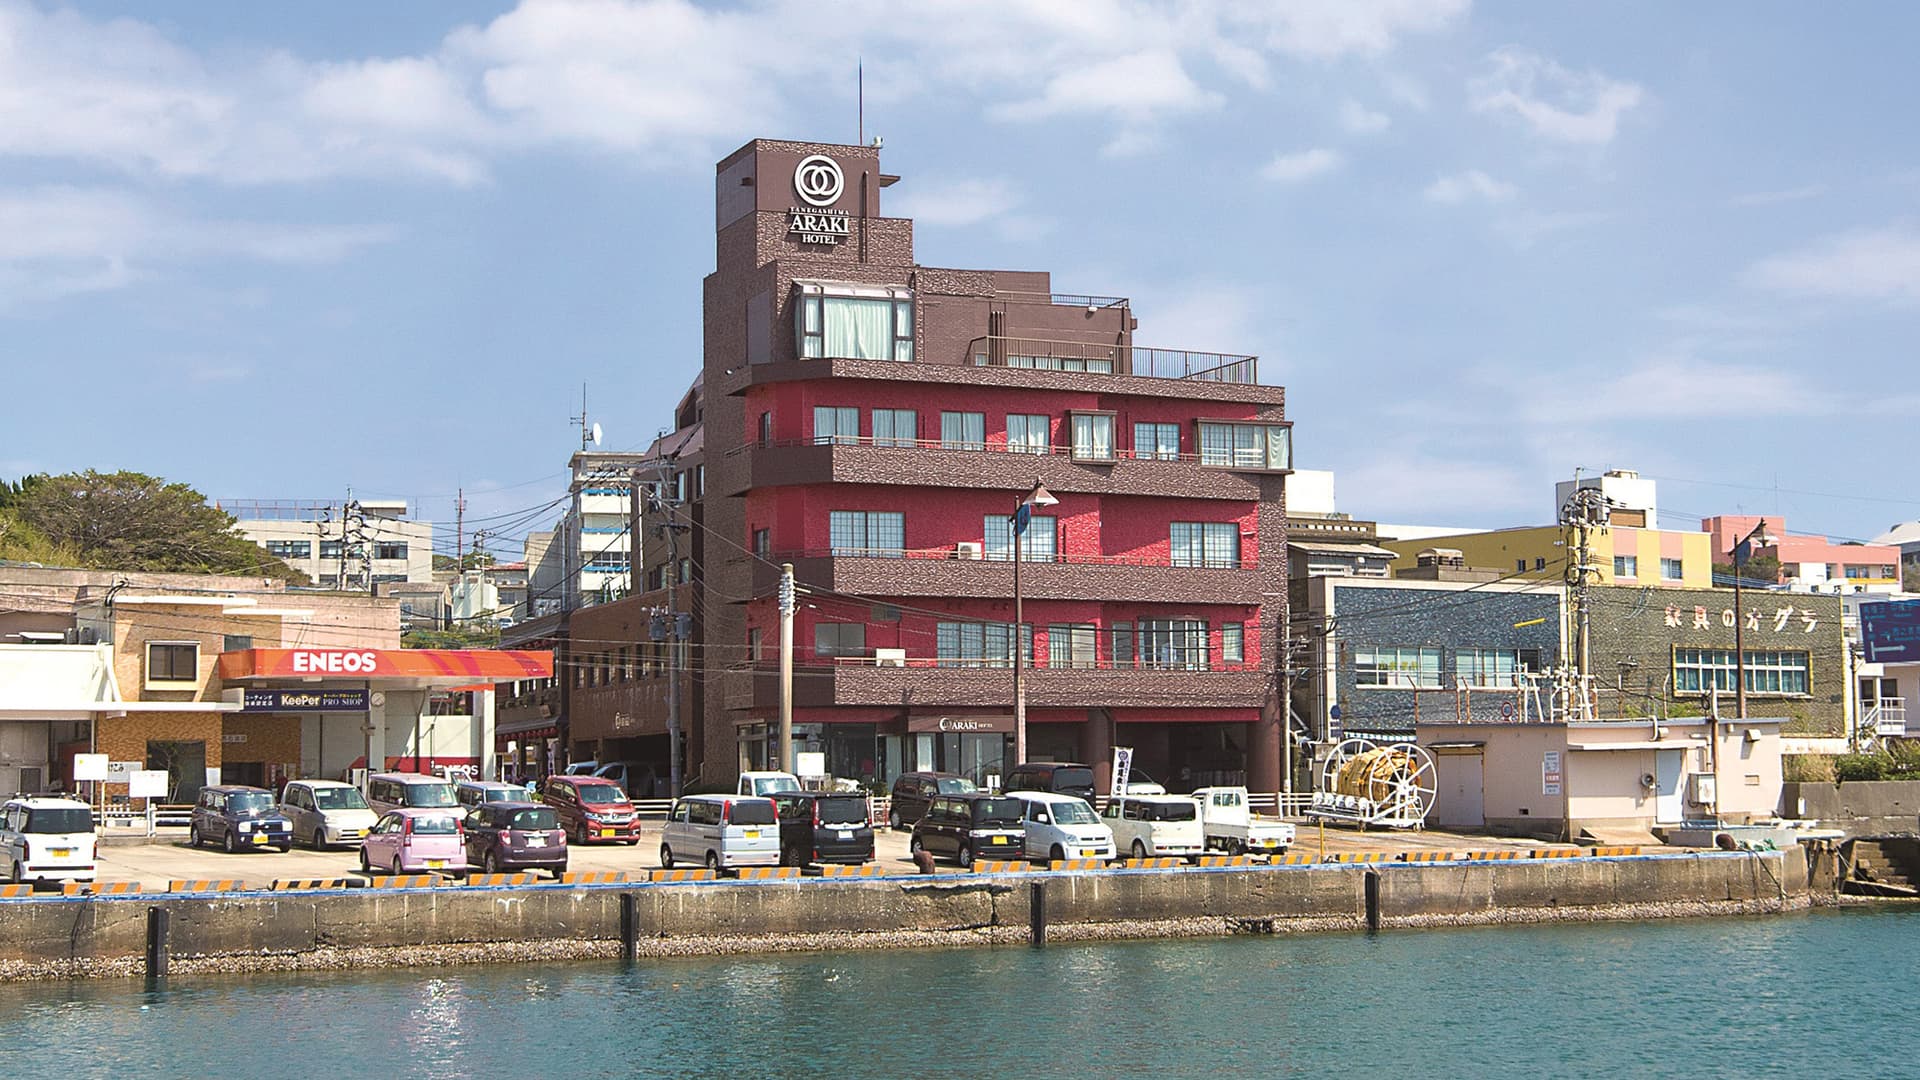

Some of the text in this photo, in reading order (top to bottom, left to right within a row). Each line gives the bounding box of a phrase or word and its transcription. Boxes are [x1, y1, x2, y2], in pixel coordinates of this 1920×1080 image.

[790, 207, 849, 215] TANEGASHIMA
[790, 215, 849, 233] ARAKI
[802, 234, 838, 245] HOTEL
[1664, 603, 1818, 633] 家具のオグラ
[293, 652, 376, 672] ENEOS
[281, 694, 320, 706] KeePer
[323, 698, 363, 706] PRO SHOP
[951, 721, 978, 730] ARAKI
